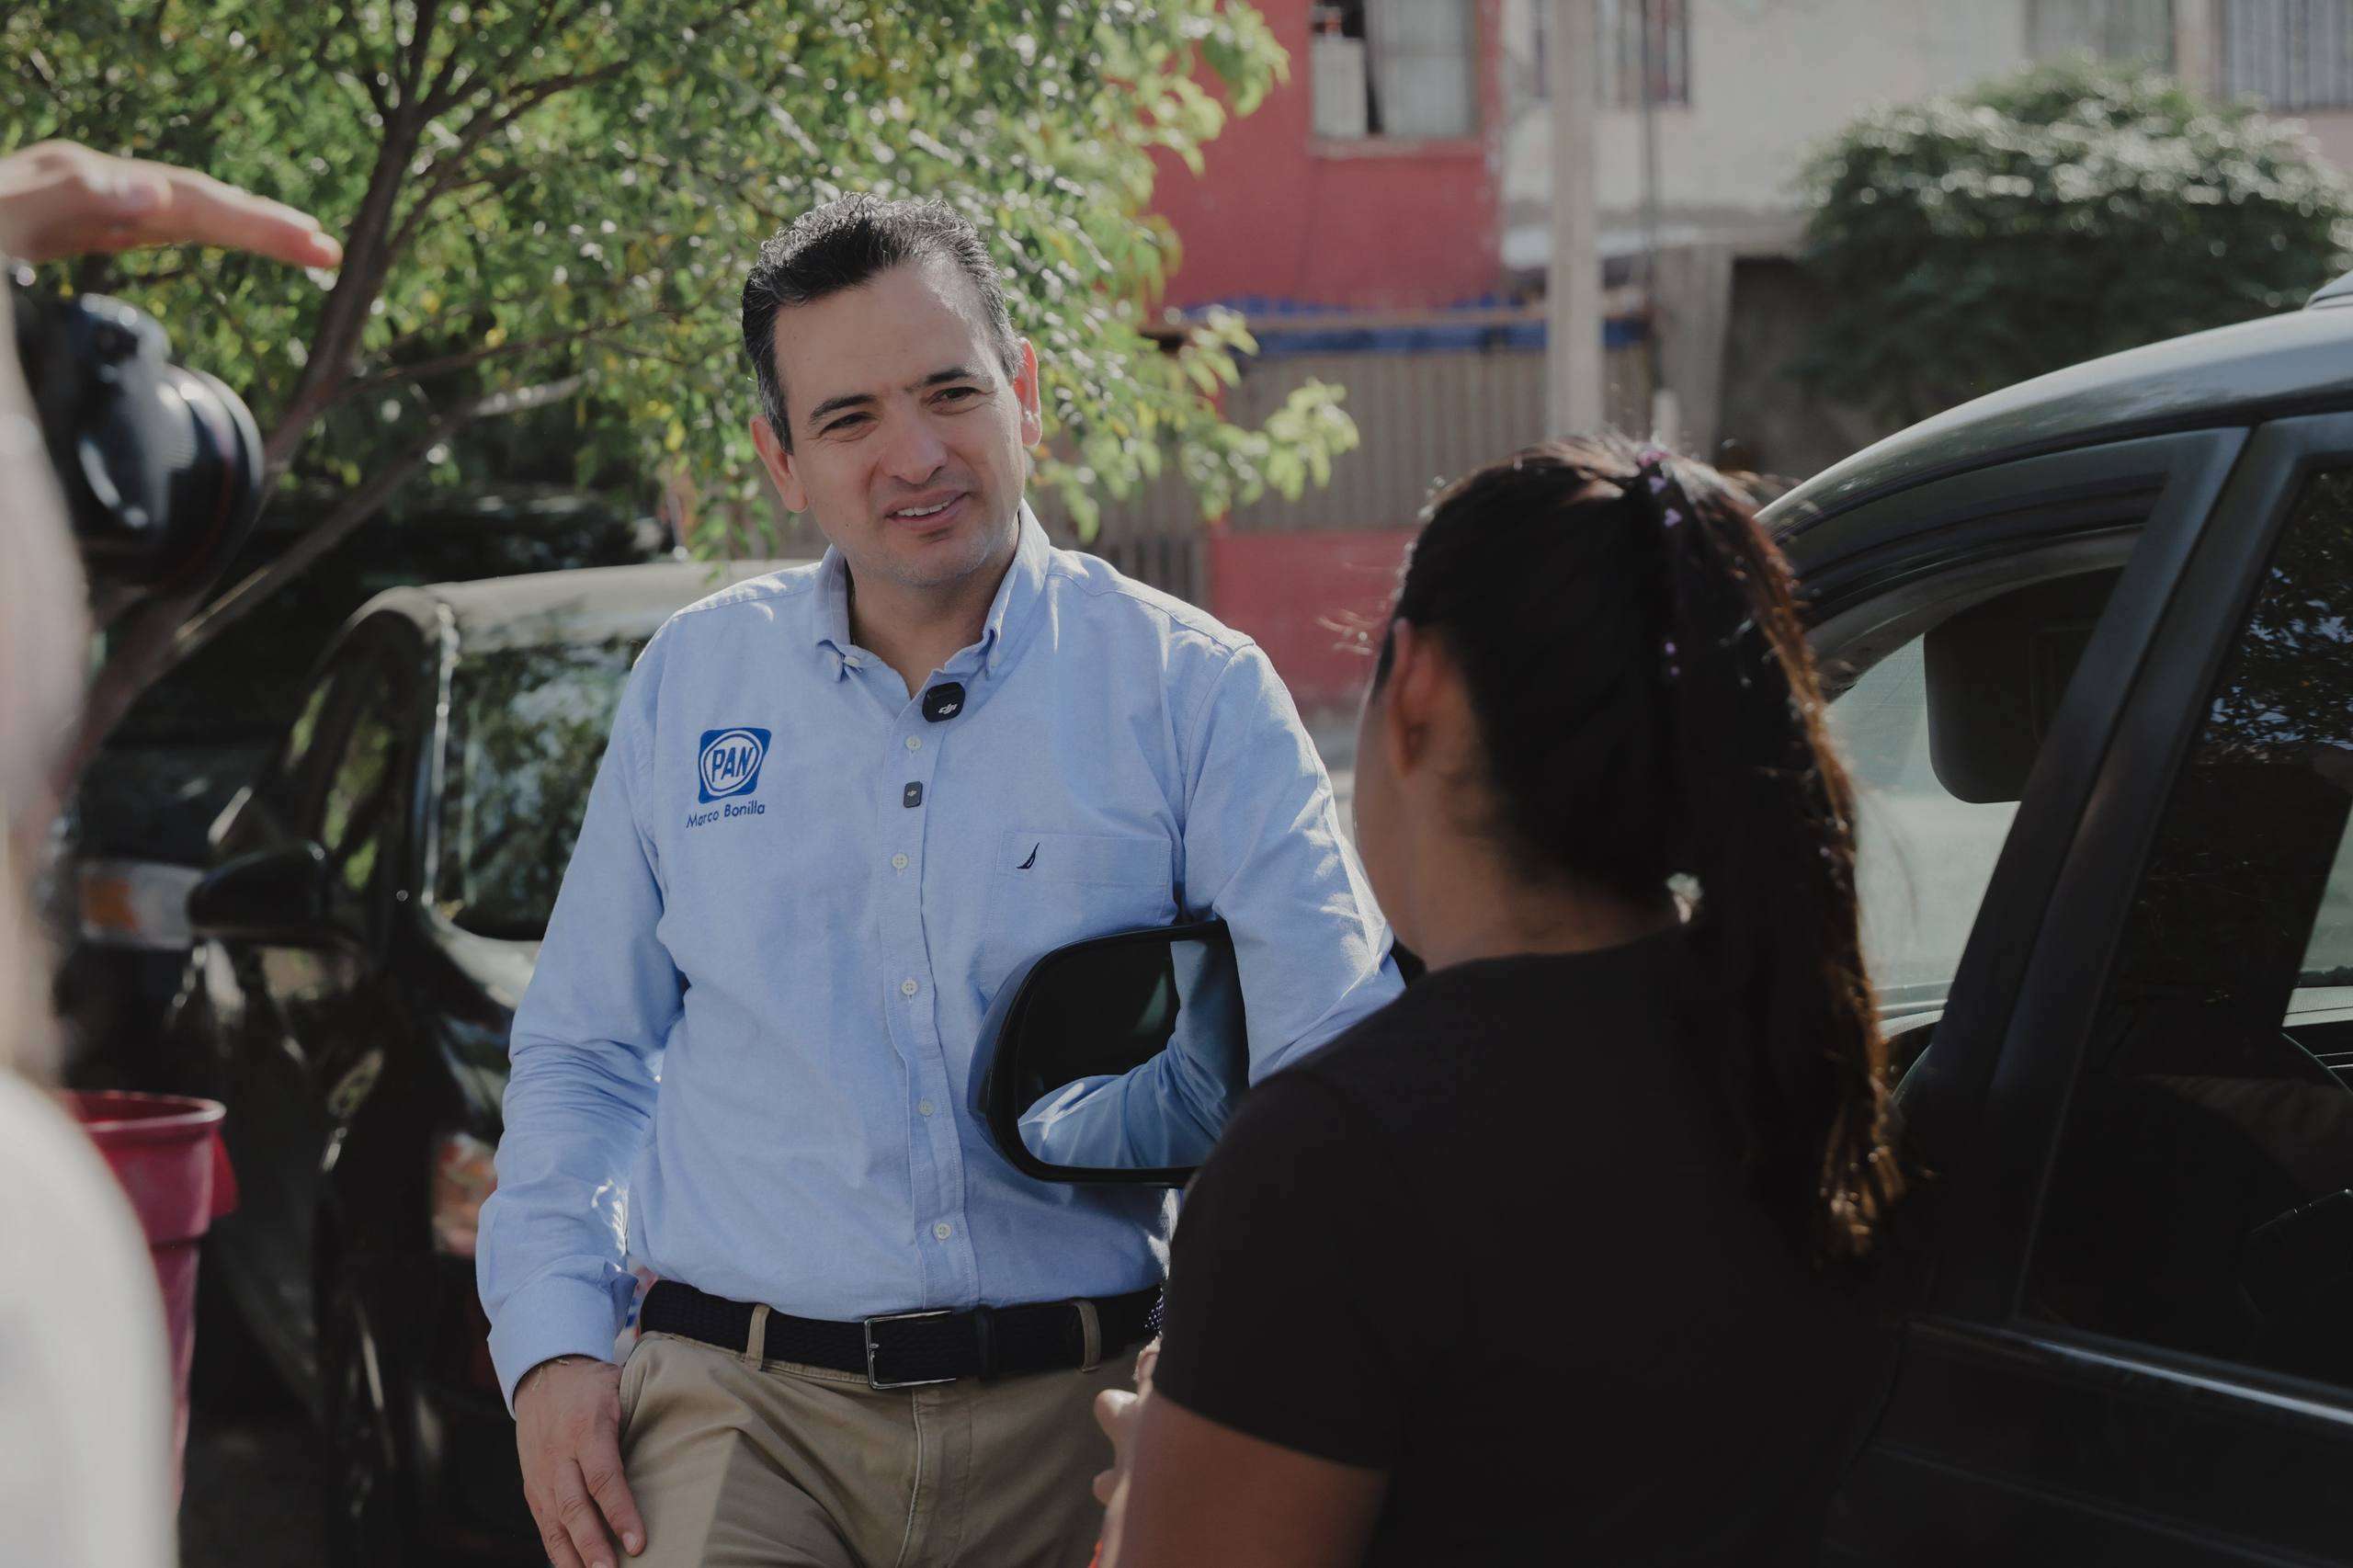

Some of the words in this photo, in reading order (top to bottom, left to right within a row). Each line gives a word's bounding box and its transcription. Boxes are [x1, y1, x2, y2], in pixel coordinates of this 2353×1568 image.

[711, 745, 755, 783] PAN
[686, 811, 720, 828] Marco
[723, 800, 766, 817] Bonilla
